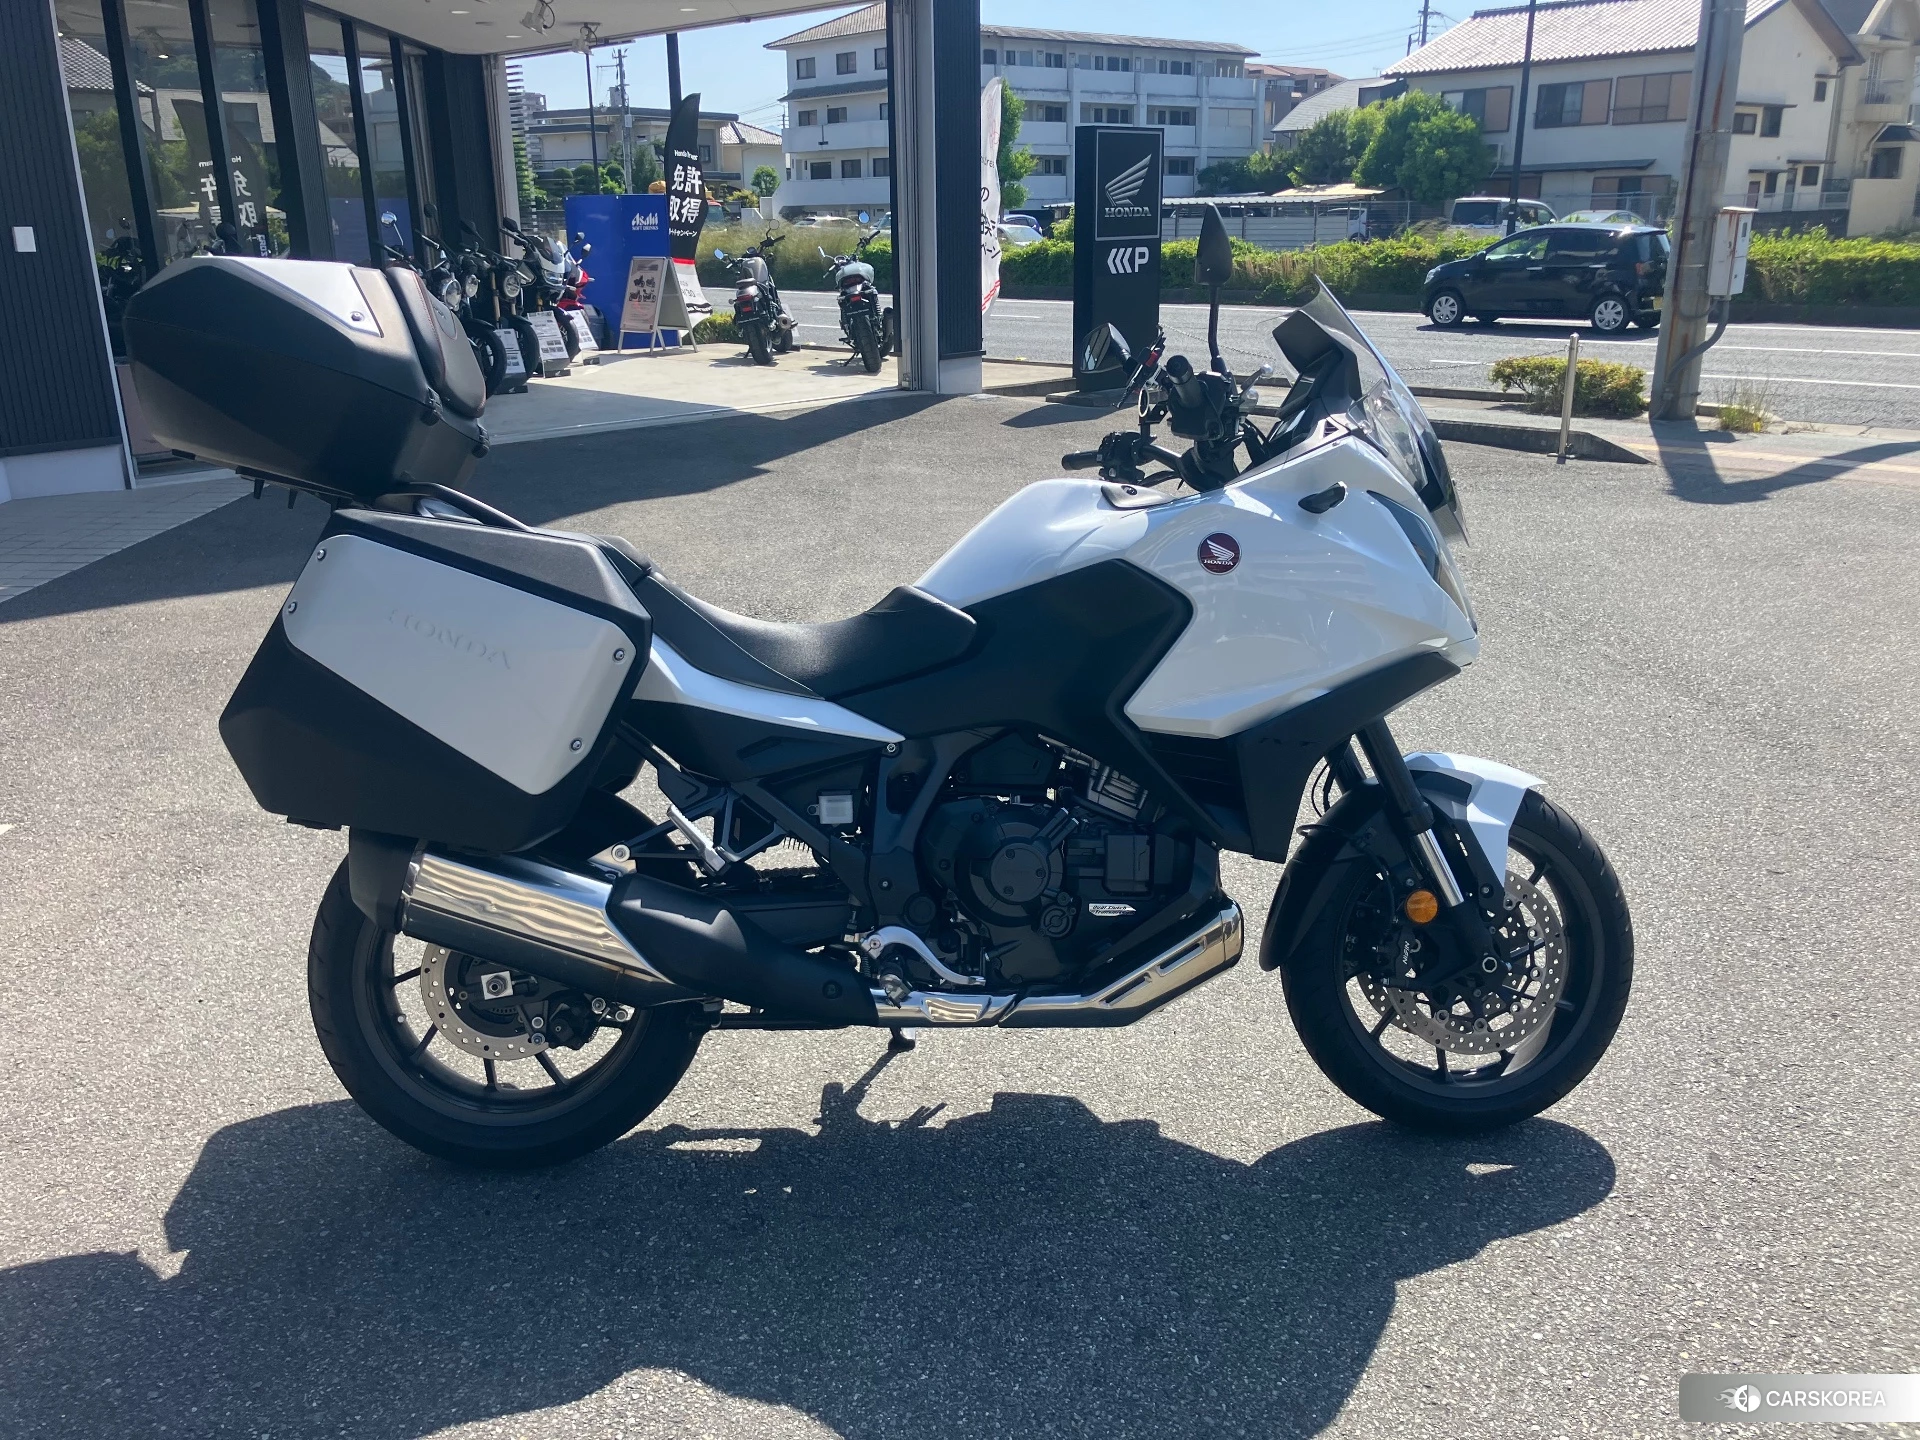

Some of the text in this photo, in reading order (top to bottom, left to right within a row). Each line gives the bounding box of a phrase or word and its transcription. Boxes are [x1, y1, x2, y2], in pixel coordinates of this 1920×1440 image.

[671, 164, 702, 194] 免許
[631, 212, 659, 226] Asahi
[669, 195, 702, 224] 取得
[1104, 207, 1152, 217] HONDA
[1134, 247, 1149, 273] P
